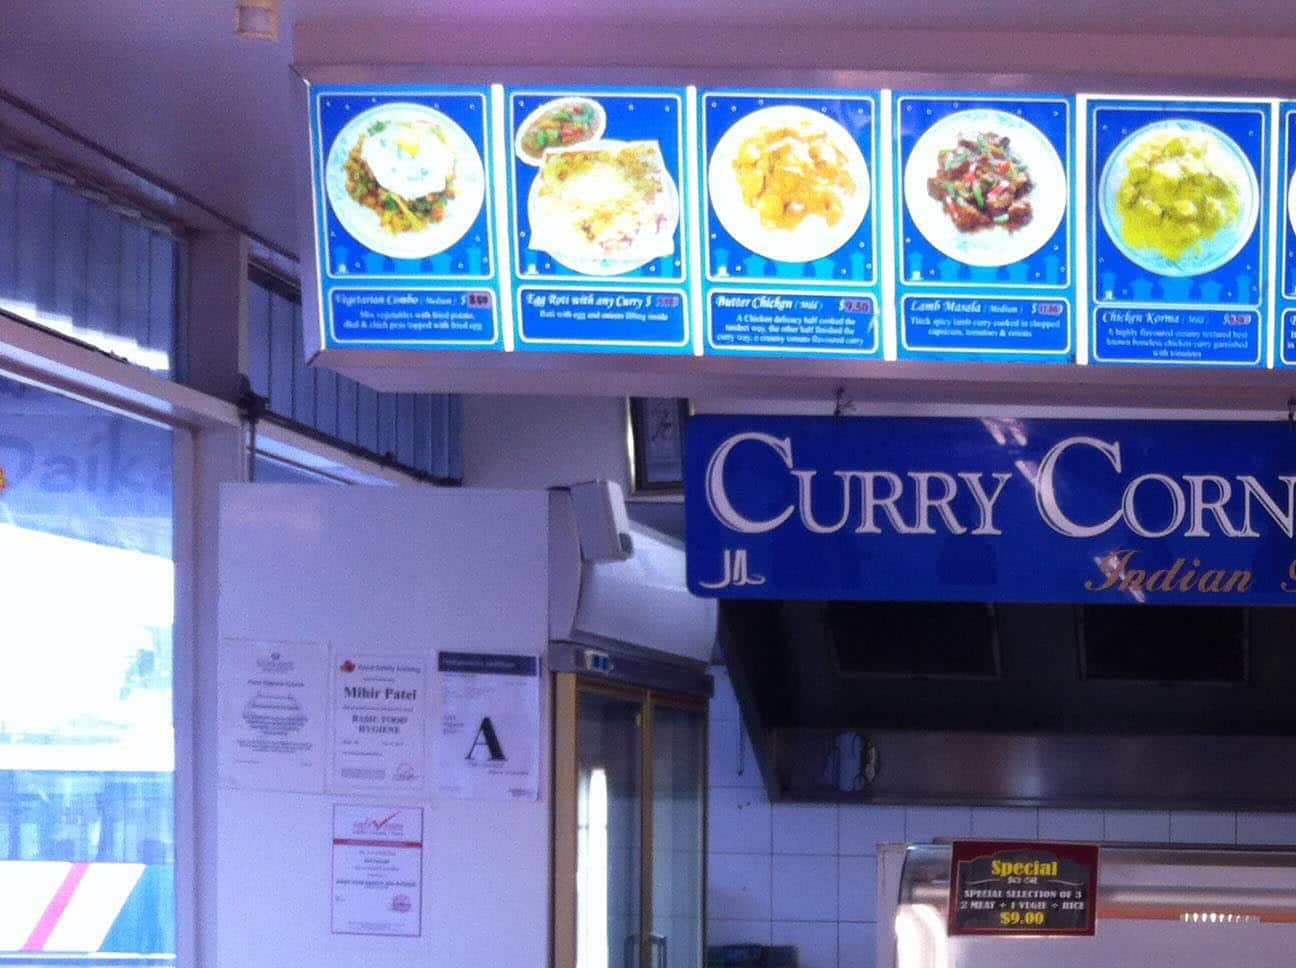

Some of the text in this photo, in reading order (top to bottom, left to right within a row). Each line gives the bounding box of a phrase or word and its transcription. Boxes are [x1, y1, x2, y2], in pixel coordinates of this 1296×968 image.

[526, 294, 643, 309] Egg Roti with any Curry
[717, 296, 749, 309] Butter
[752, 297, 793, 311] Chicken
[911, 300, 982, 314] Lamb Masala
[1102, 311, 1180, 325] Chicken Korma
[705, 431, 1013, 536] CURRY
[1085, 548, 1253, 594] Indian
[344, 686, 417, 701] Mihir Patel
[464, 716, 509, 761] A
[991, 860, 1058, 878] Special
[963, 889, 1006, 899] SPECIAL
[1006, 889, 1057, 899] SELECTION
[1060, 890, 1072, 899] OF
[960, 900, 968, 910] 2
[969, 900, 996, 910] MEAT
[1018, 901, 1047, 910] VEGIE
[1062, 901, 1085, 910] RICE
[1000, 911, 1044, 926] $9.00
